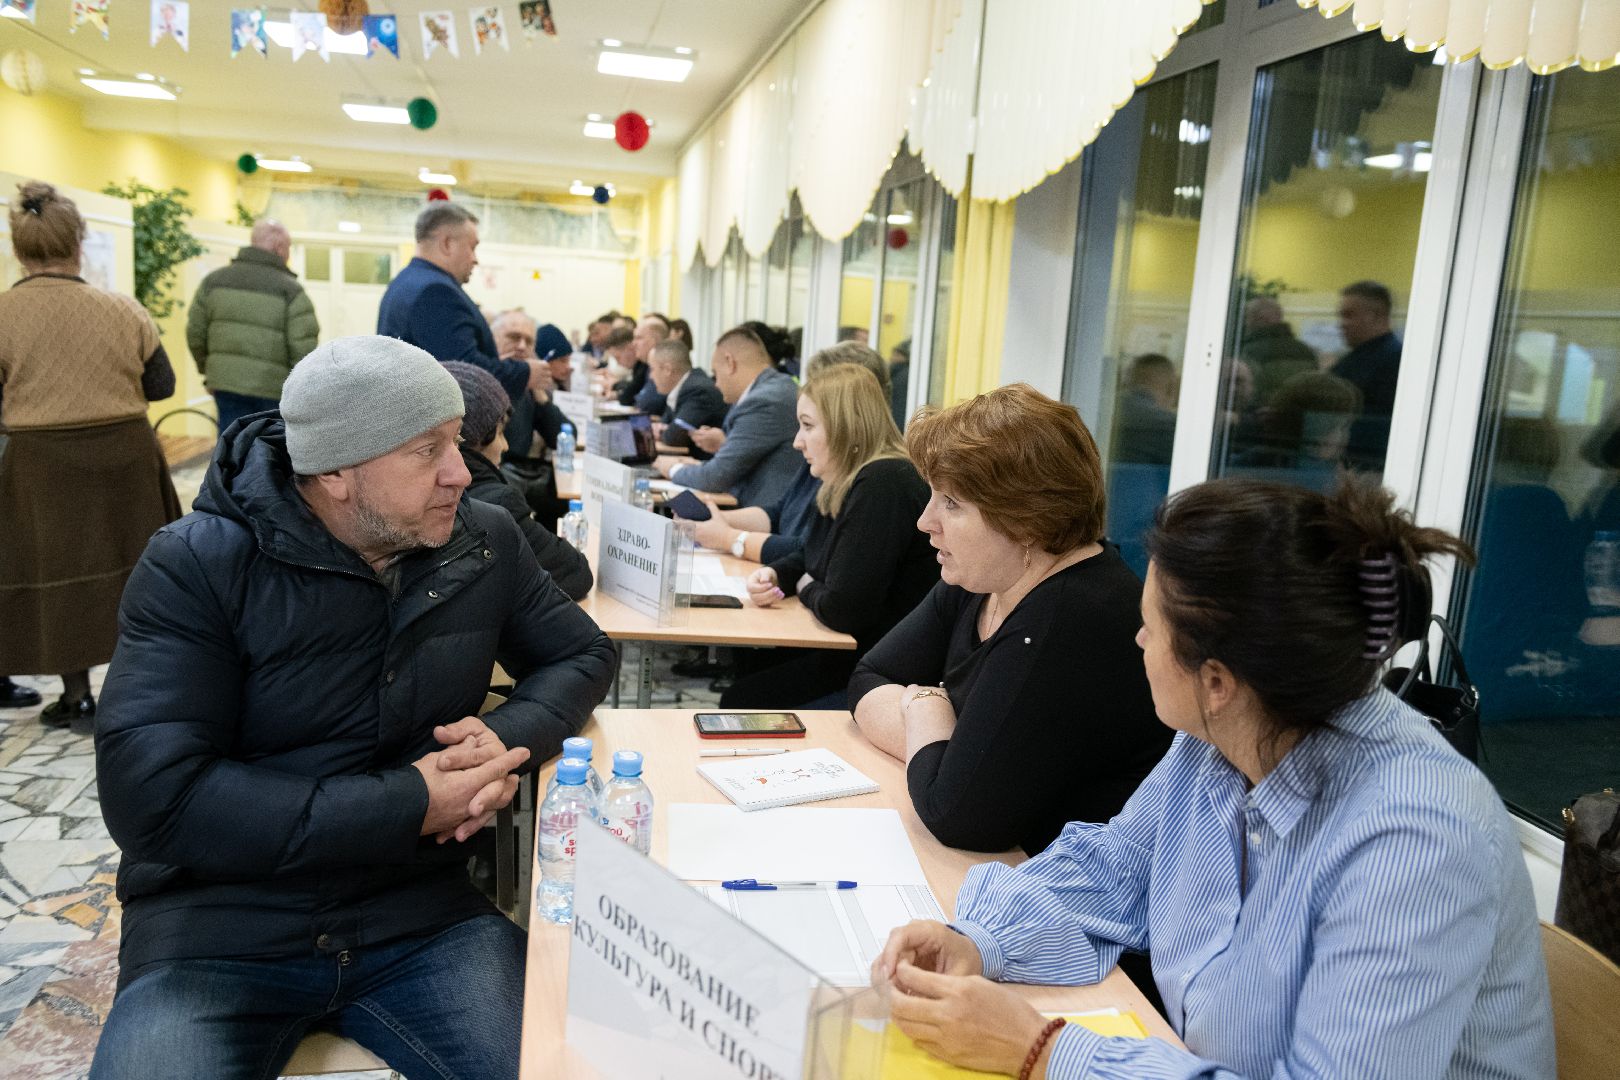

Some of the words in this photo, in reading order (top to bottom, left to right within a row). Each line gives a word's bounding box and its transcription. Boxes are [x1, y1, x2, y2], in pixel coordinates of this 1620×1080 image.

[607, 544, 659, 576] ОХРАНЕНИЕ
[617, 527, 651, 550] ЗДРАВО-
[574, 914, 673, 1015] КУЛЬТУРА
[679, 998, 696, 1031] И
[702, 1019, 786, 1080] СПОР
[598, 894, 760, 1036] ОБРАЗОВАНИЕ
